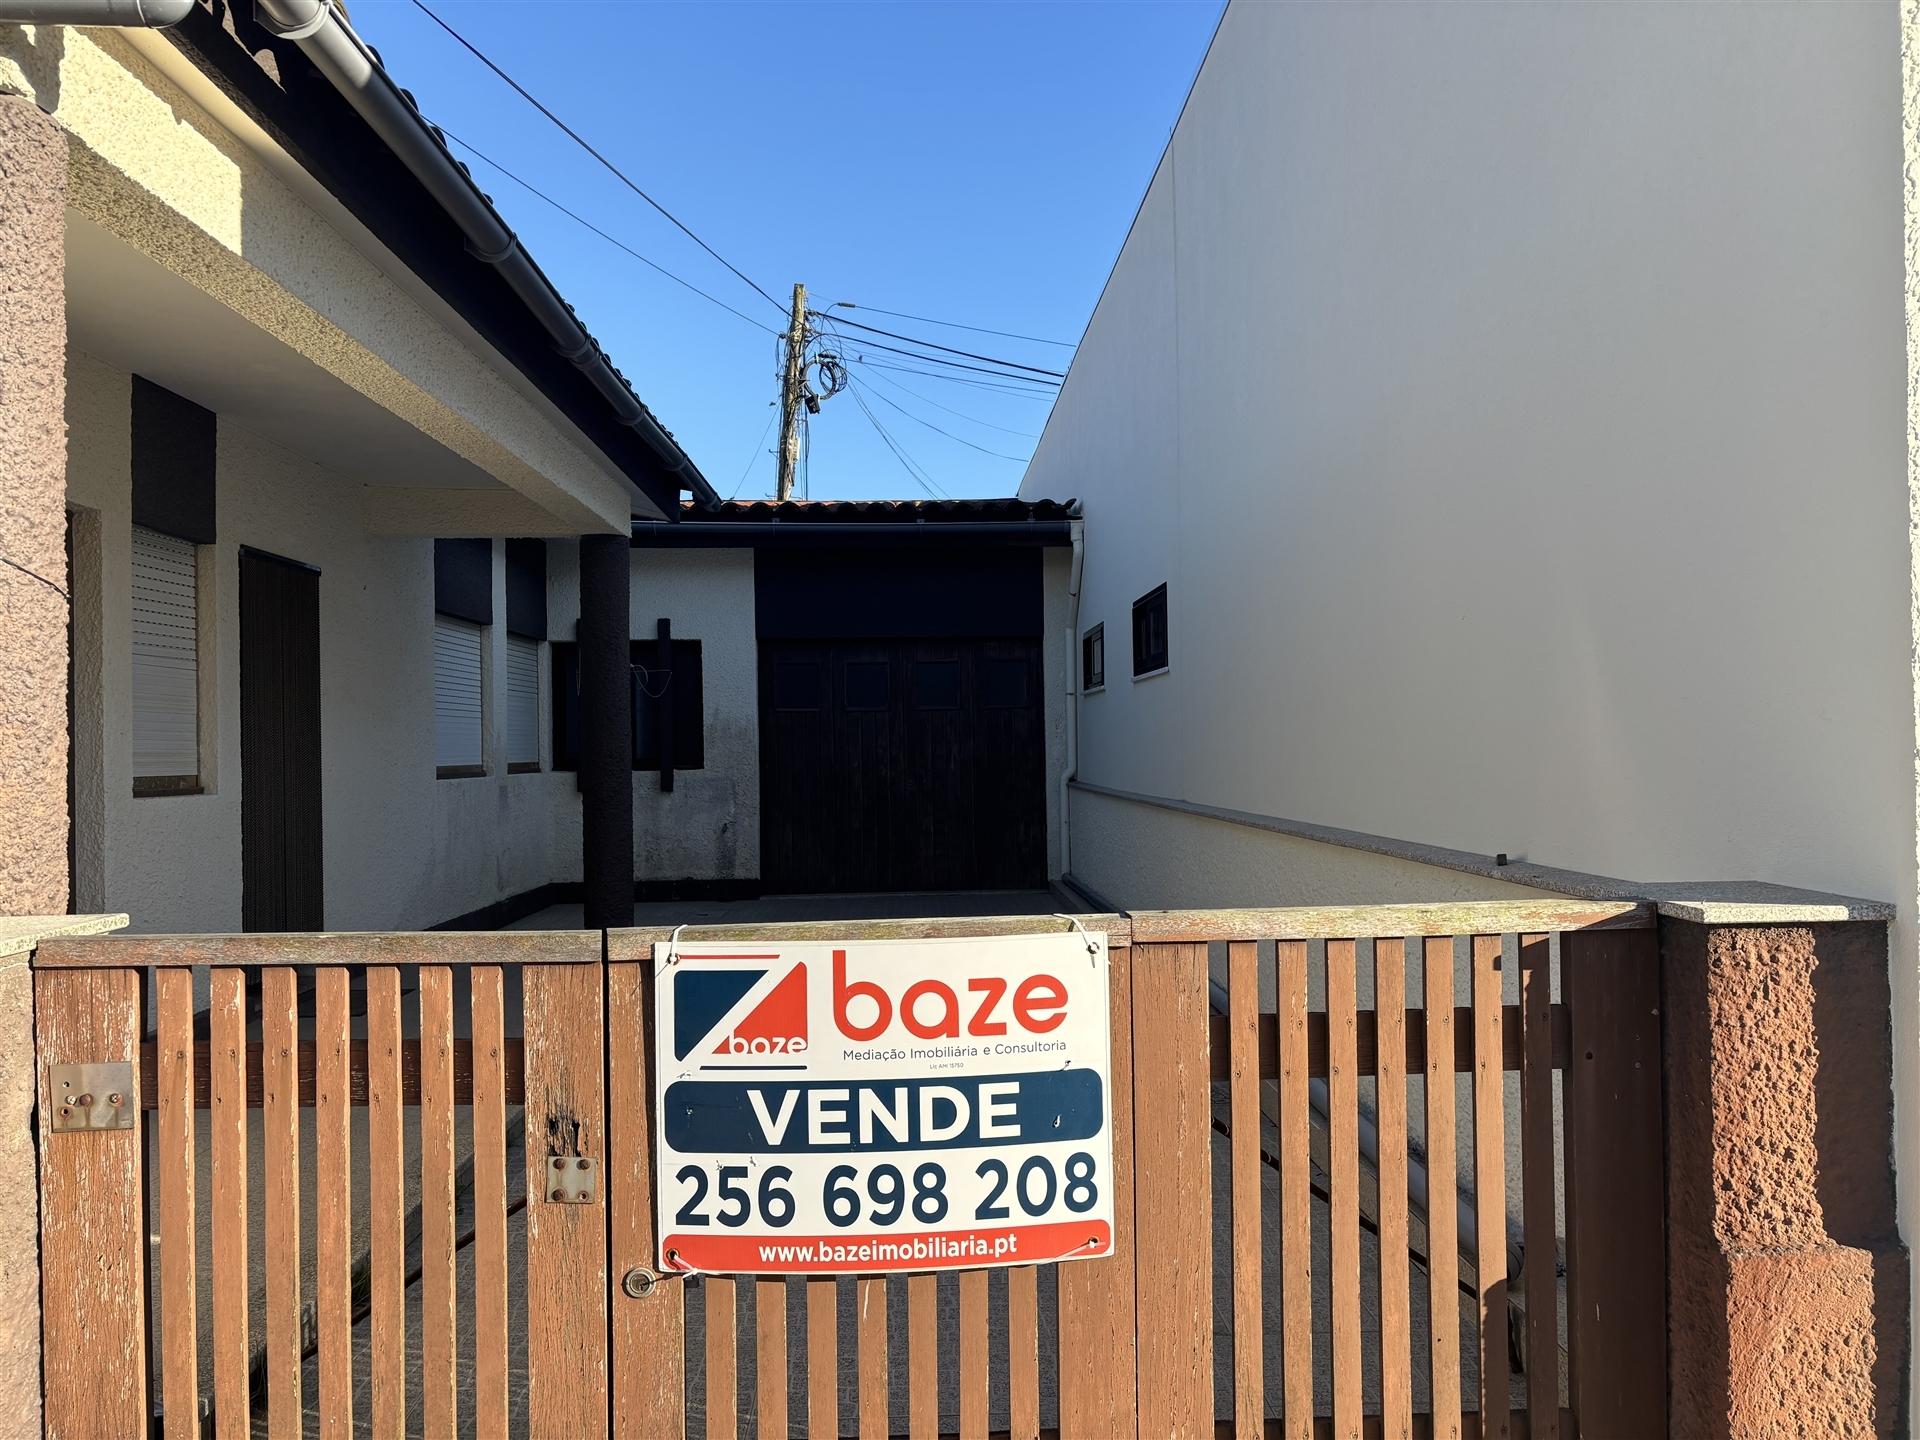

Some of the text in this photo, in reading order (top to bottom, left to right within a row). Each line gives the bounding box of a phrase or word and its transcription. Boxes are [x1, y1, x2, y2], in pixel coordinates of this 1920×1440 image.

[832, 949, 1069, 1042] baze
[728, 1034, 808, 1055] baze
[843, 1040, 1067, 1062] Mediação Imobiliária e Consultoria
[748, 1081, 1022, 1146] VENDE
[675, 1151, 1099, 1228] 256 698 208
[758, 1233, 1018, 1264] www.bazeimobiliaria.pt
